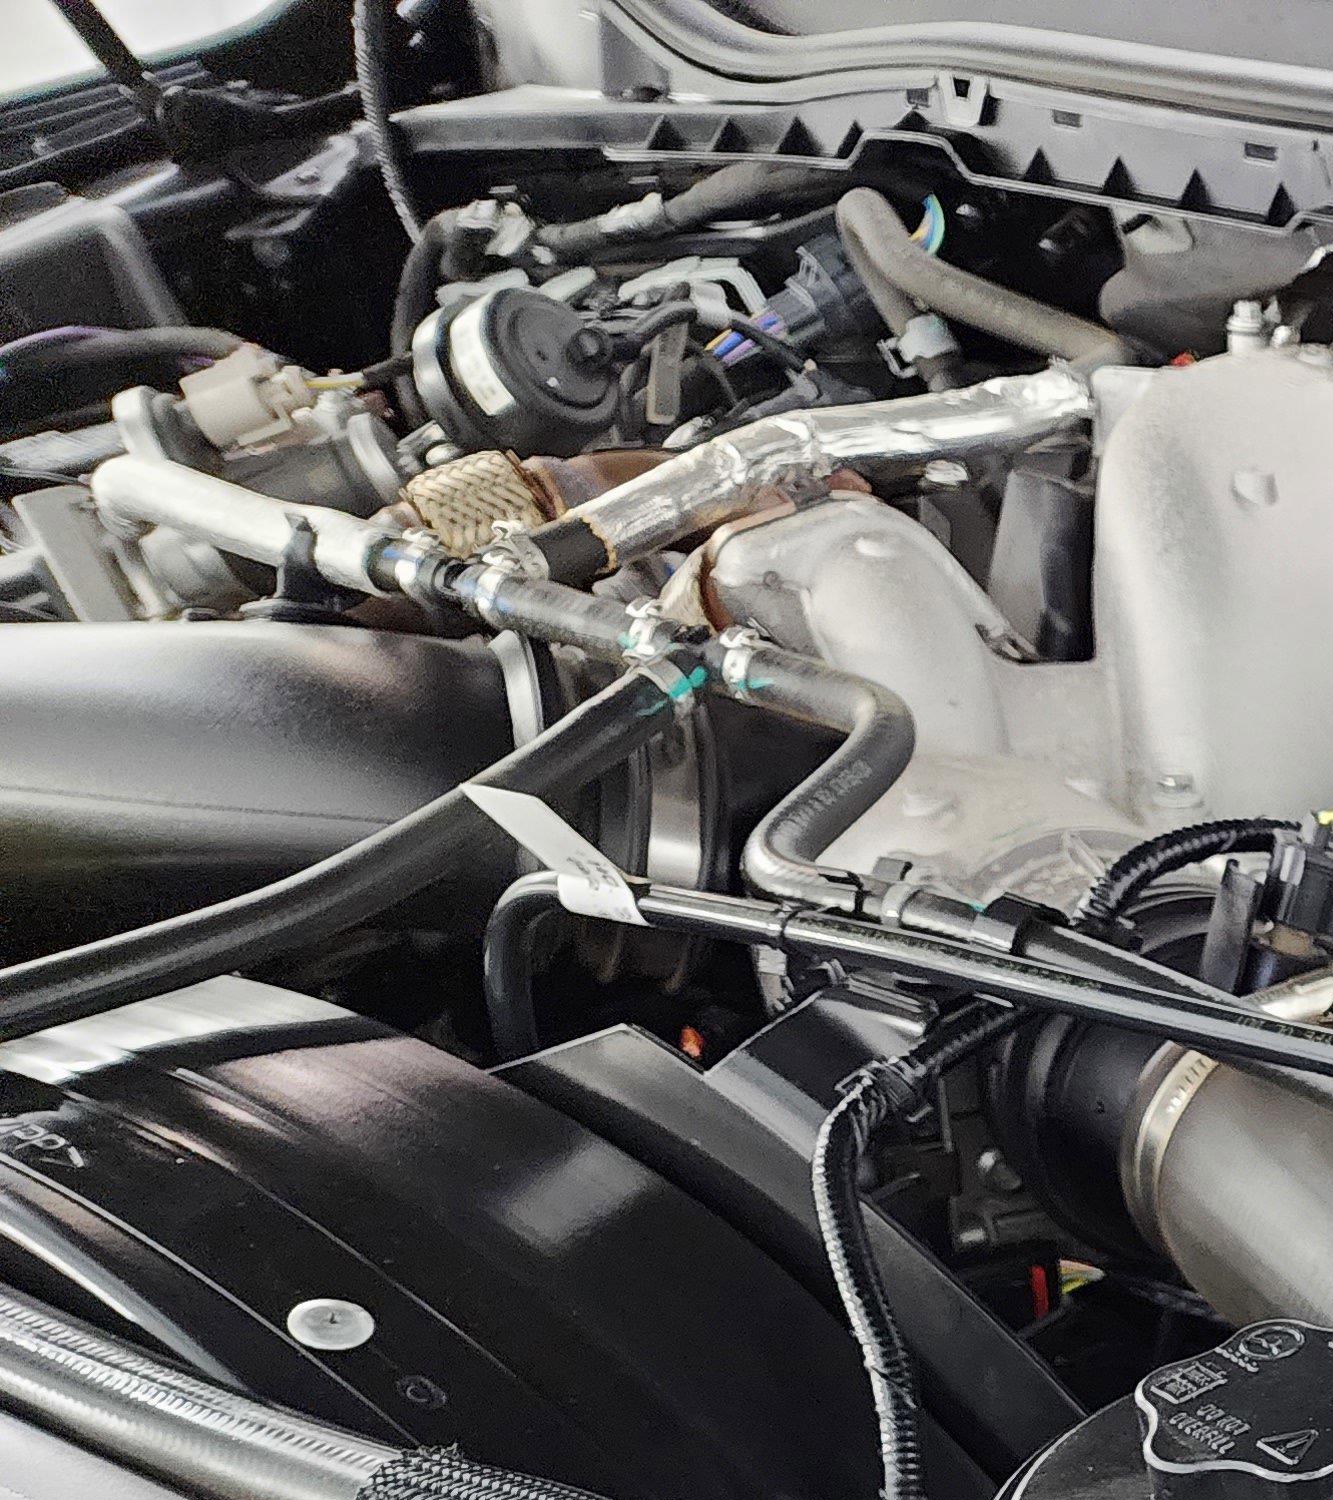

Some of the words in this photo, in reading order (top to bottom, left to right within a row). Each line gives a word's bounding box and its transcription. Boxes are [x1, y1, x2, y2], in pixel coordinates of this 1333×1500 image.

[1168, 1411, 1236, 1454] OVERFILL
[1195, 1403, 1226, 1420] DO
[1215, 1414, 1252, 1435] NOT
